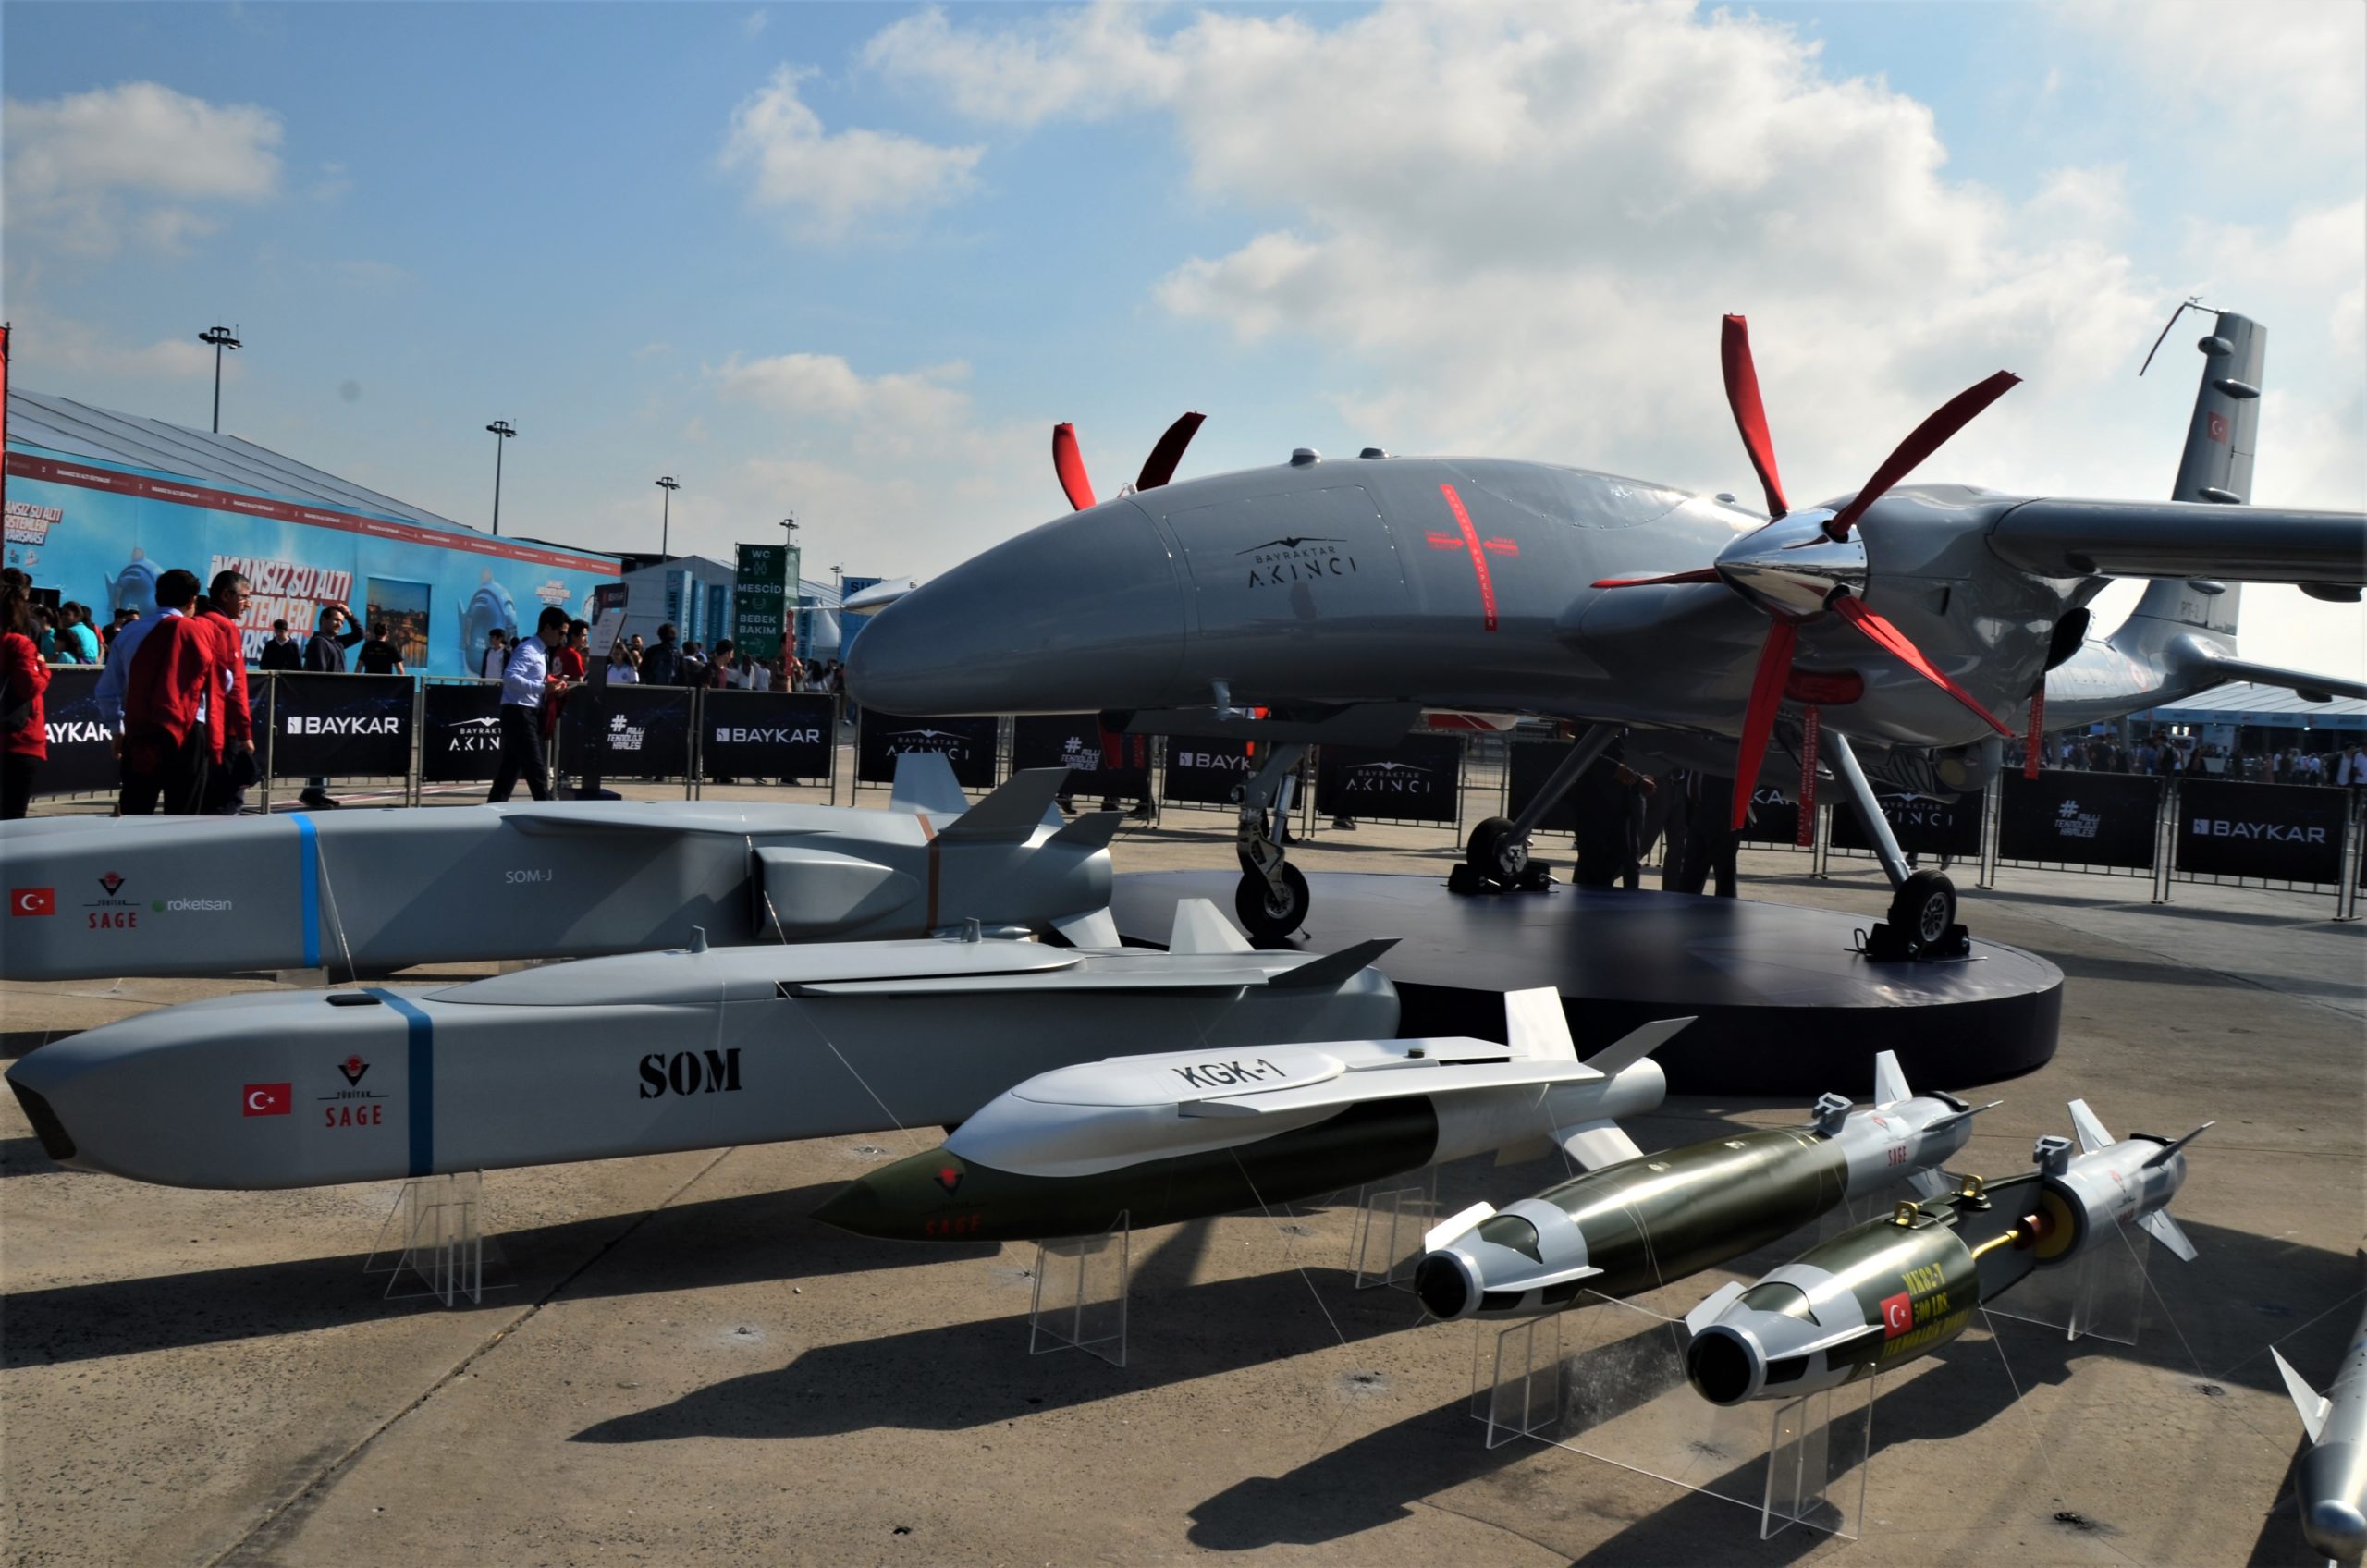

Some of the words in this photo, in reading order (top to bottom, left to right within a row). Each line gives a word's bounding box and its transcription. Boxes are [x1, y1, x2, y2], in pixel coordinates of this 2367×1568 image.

[751, 549, 771, 559] WC
[1255, 546, 1336, 564] BAYRAKTAR
[1248, 557, 1357, 589] AKINCI
[287, 567, 315, 599] SU
[313, 569, 350, 602] ALTI
[738, 582, 782, 594] MESCİD
[235, 594, 315, 631] STEMLERİ
[740, 615, 777, 624] BEBEK
[740, 625, 777, 636] BAKIM
[43, 721, 113, 744] AYKAR
[305, 717, 399, 734] BAYKAR
[460, 727, 501, 735] BAYRAKT
[448, 736, 501, 751] AKIN
[732, 728, 820, 743] BAYKAR
[1196, 753, 1250, 771] BAYK
[1346, 778, 1430, 793] AKINCI
[1883, 802, 1942, 811] AYRAKTAR
[2213, 819, 2326, 844] BAYKAR
[505, 869, 552, 884] SOM-J
[167, 898, 232, 911] roketsan
[89, 912, 137, 929] SAGE
[639, 1047, 742, 1099] SOM
[1171, 1058, 1287, 1089] KGK-1
[325, 1105, 382, 1128] SAGE
[1888, 1146, 1907, 1167] SAGE
